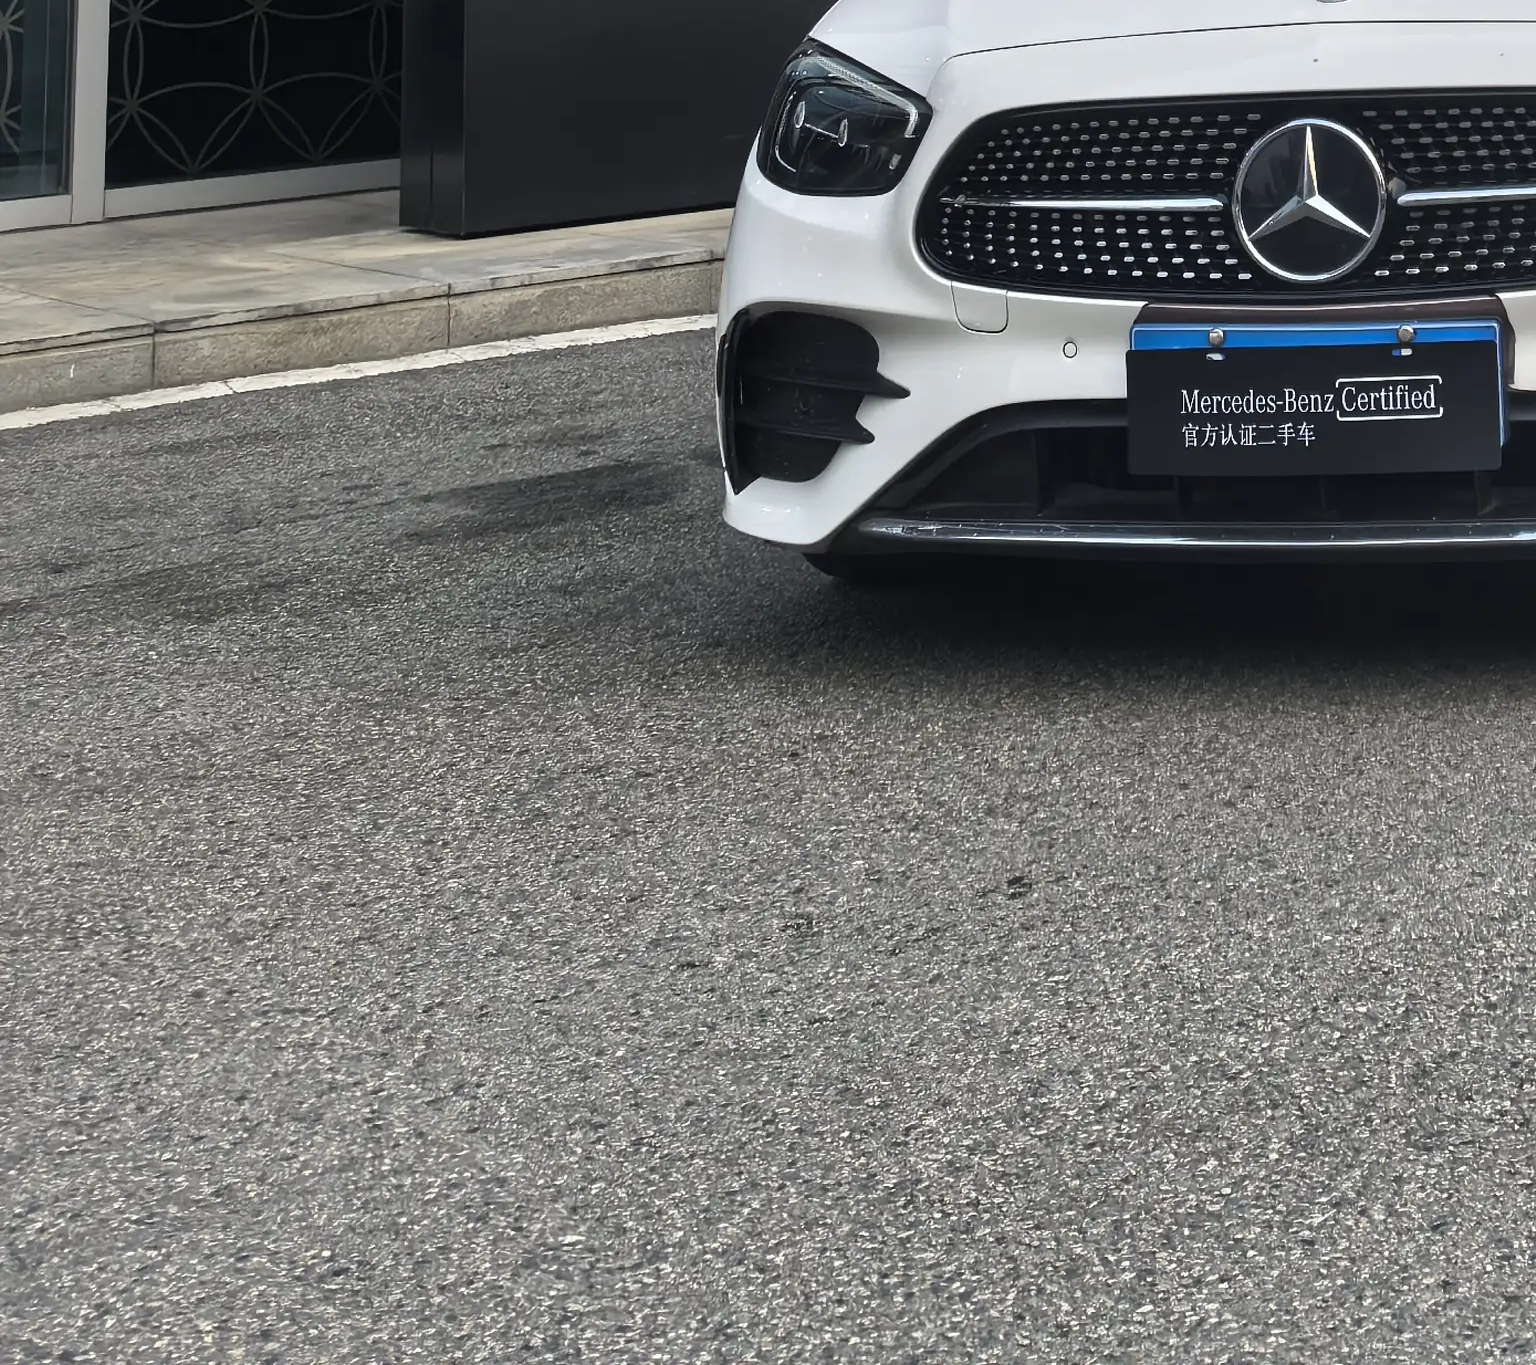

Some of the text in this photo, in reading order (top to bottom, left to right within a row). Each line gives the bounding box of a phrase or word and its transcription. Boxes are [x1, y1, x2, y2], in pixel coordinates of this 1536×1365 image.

[1180, 384, 1437, 414] Mercedes-Benz Certified
[1182, 421, 1316, 447] 官方认证二手车
